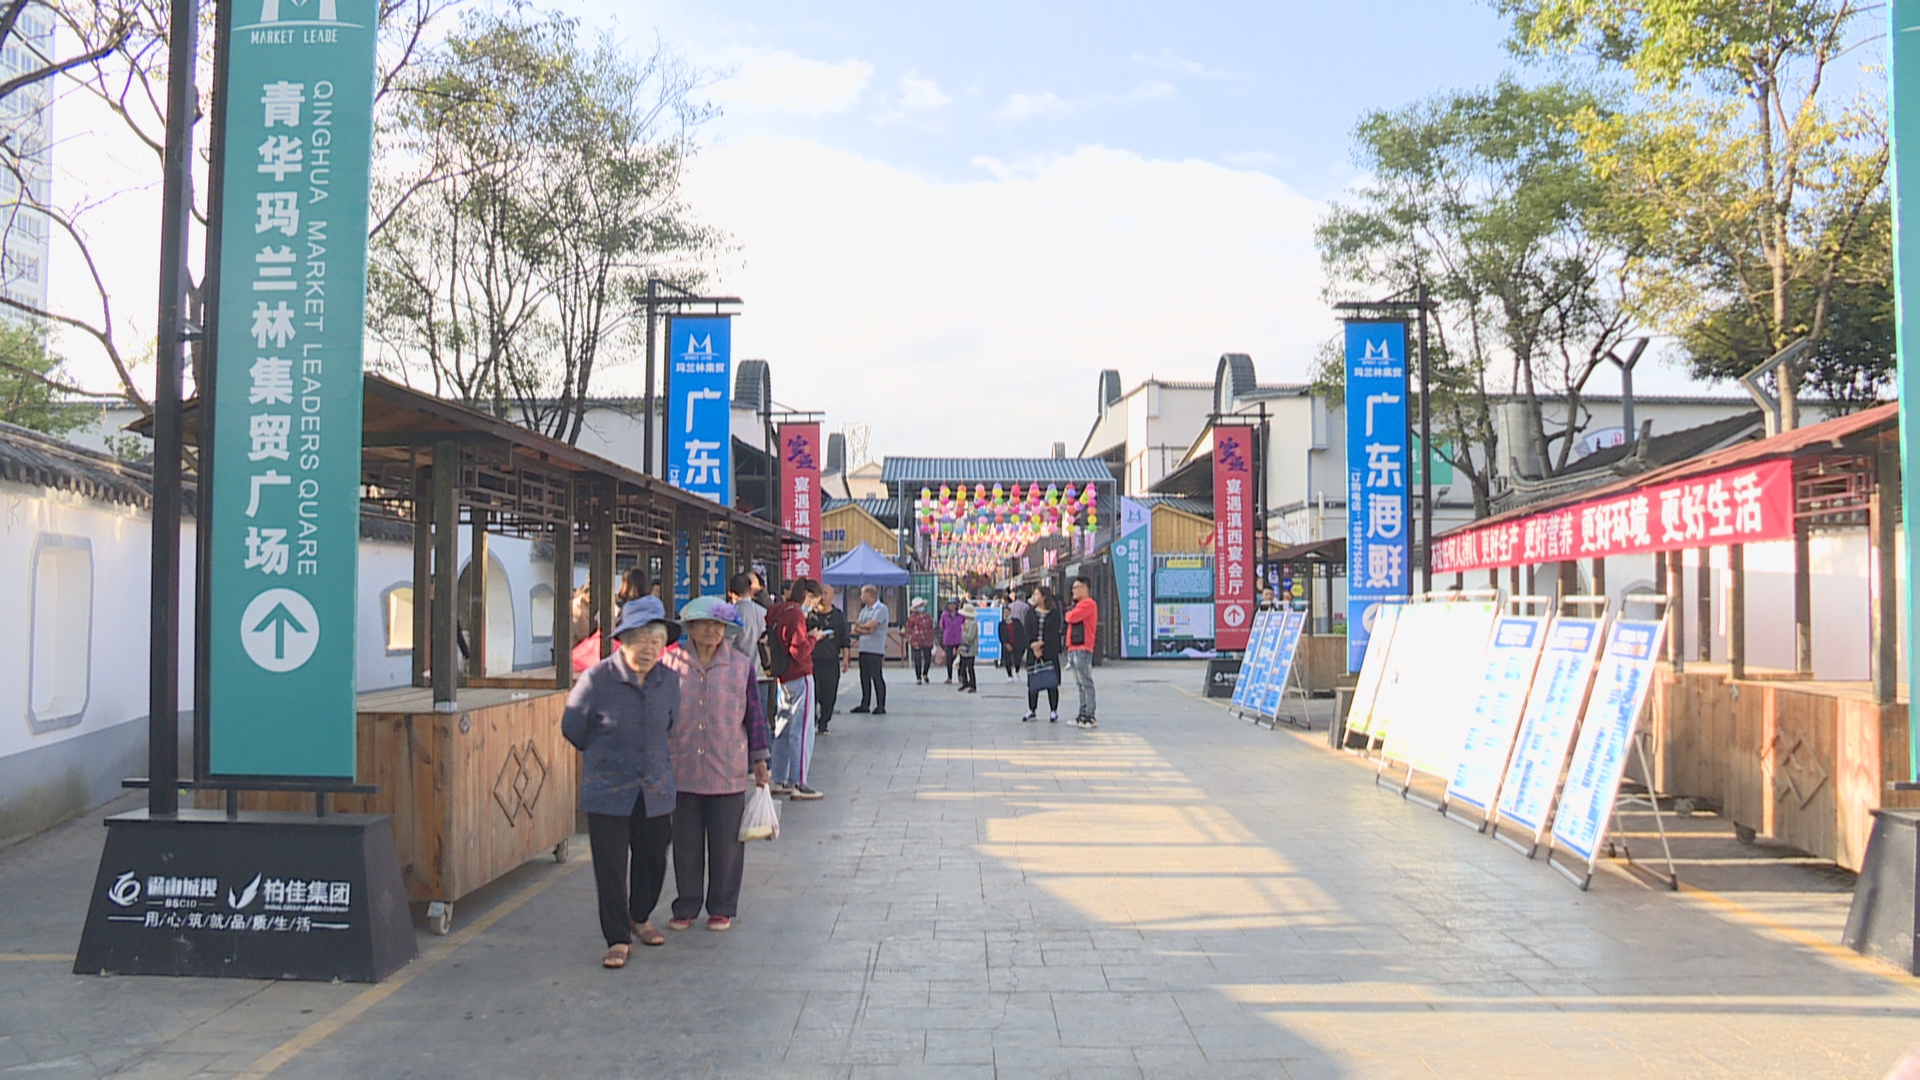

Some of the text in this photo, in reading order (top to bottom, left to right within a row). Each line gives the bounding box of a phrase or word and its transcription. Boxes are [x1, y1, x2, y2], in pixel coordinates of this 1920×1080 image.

[250, 28, 338, 45] MARKET LEADE
[243, 80, 306, 576] 青华玛兰林集贸广场
[297, 80, 334, 576] QINGHUA MARKET LEADERS QUARE
[1226, 478, 1243, 595] 宴遇滇西宴会厅
[1365, 391, 1403, 588] 广东海鲜
[1481, 523, 1519, 563] 更好生产
[1523, 511, 1574, 559] 更好营养
[1580, 494, 1651, 551] 更好环境
[1659, 471, 1763, 543] 更好生活
[1127, 538, 1140, 648] 青华玛兰林集贸广场
[146, 875, 218, 898] 保山城投
[164, 898, 198, 909] BSCID
[263, 878, 350, 905] 柏佳集团
